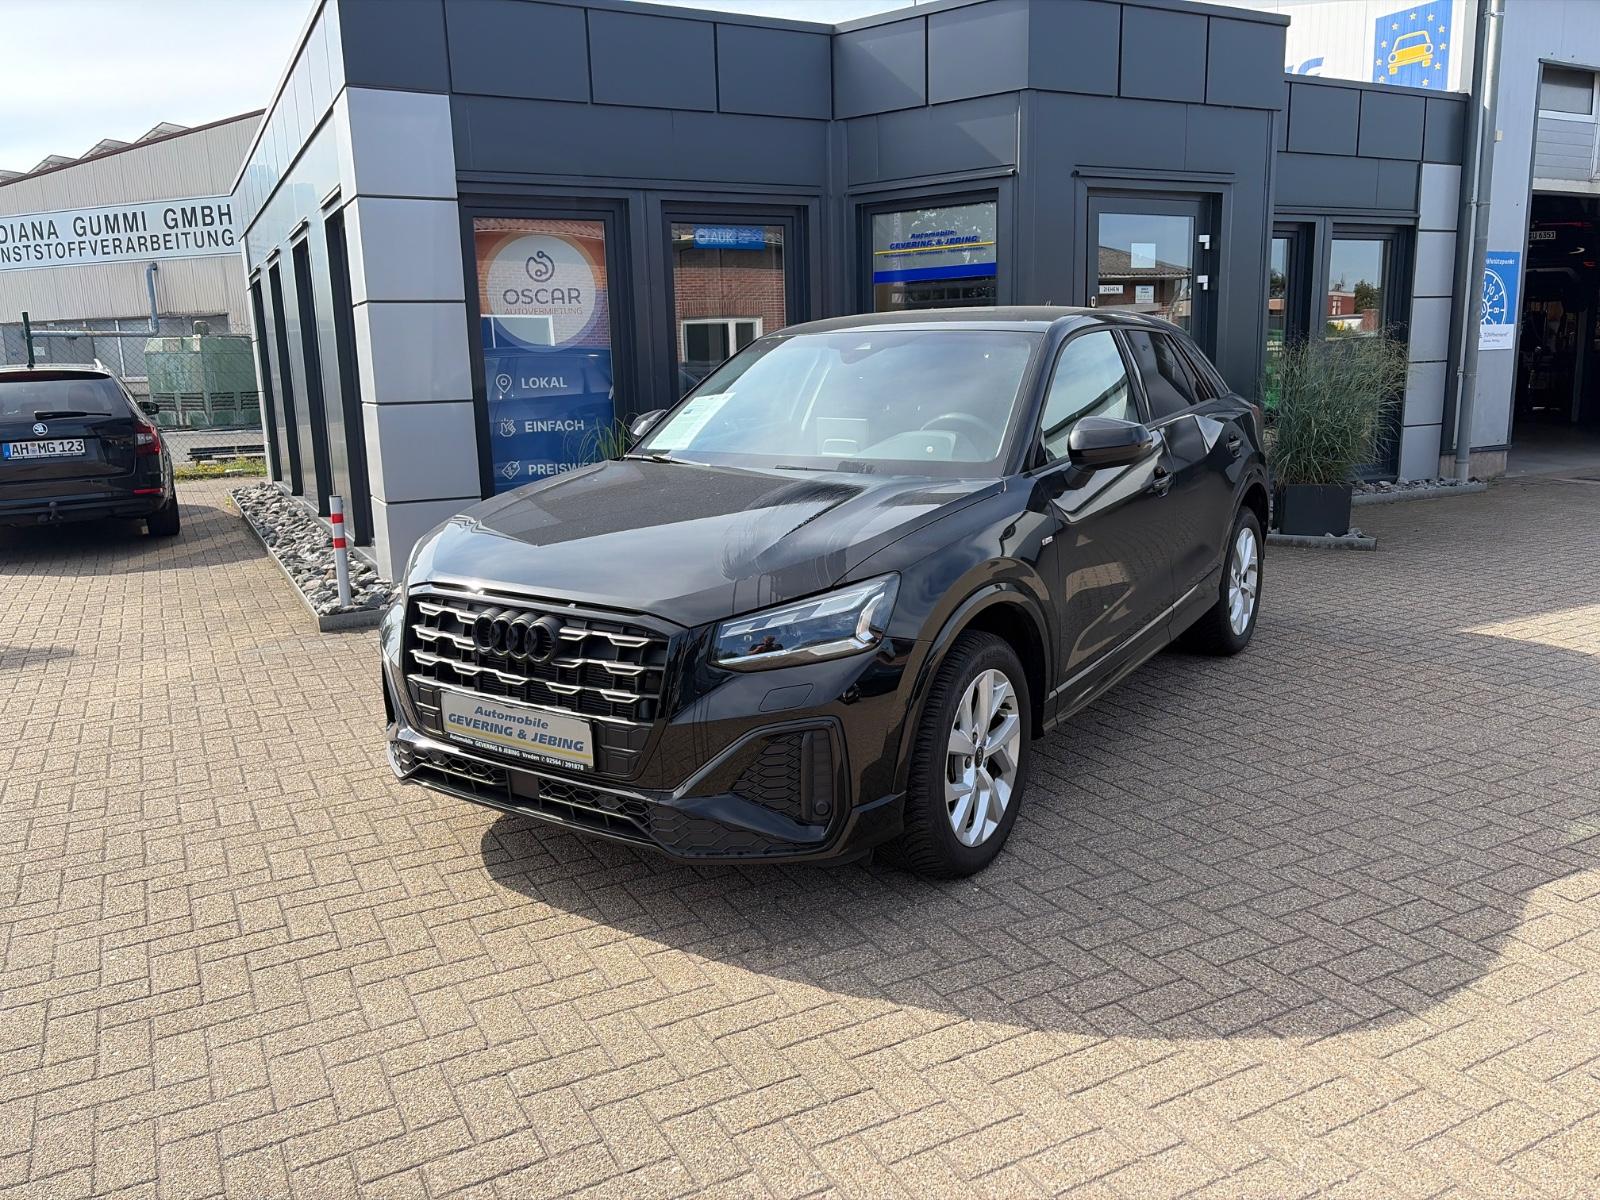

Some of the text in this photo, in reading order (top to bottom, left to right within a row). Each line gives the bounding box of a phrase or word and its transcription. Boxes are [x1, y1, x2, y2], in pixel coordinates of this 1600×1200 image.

[0, 204, 233, 244] DIANA GUMMI GMBH
[0, 228, 235, 263] NSTSTOFFVERARBEITUNG
[889, 240, 935, 250] GEVERING
[944, 235, 978, 245] JEBING
[503, 288, 582, 305] OSCAR
[504, 306, 583, 315] AUTOVERMIETUNG
[521, 376, 568, 389] LOKAL
[524, 419, 585, 433] EINFACH
[12, 443, 29, 456] AH
[37, 442, 56, 454] MG
[59, 440, 84, 452] 123
[474, 705, 549, 730] Automobile
[448, 712, 585, 752] GEVERING & JEBING
[449, 734, 474, 745] Automobile
[474, 740, 498, 752] GEVERING
[503, 747, 521, 757] JEBING
[522, 752, 540, 761] Vreden
